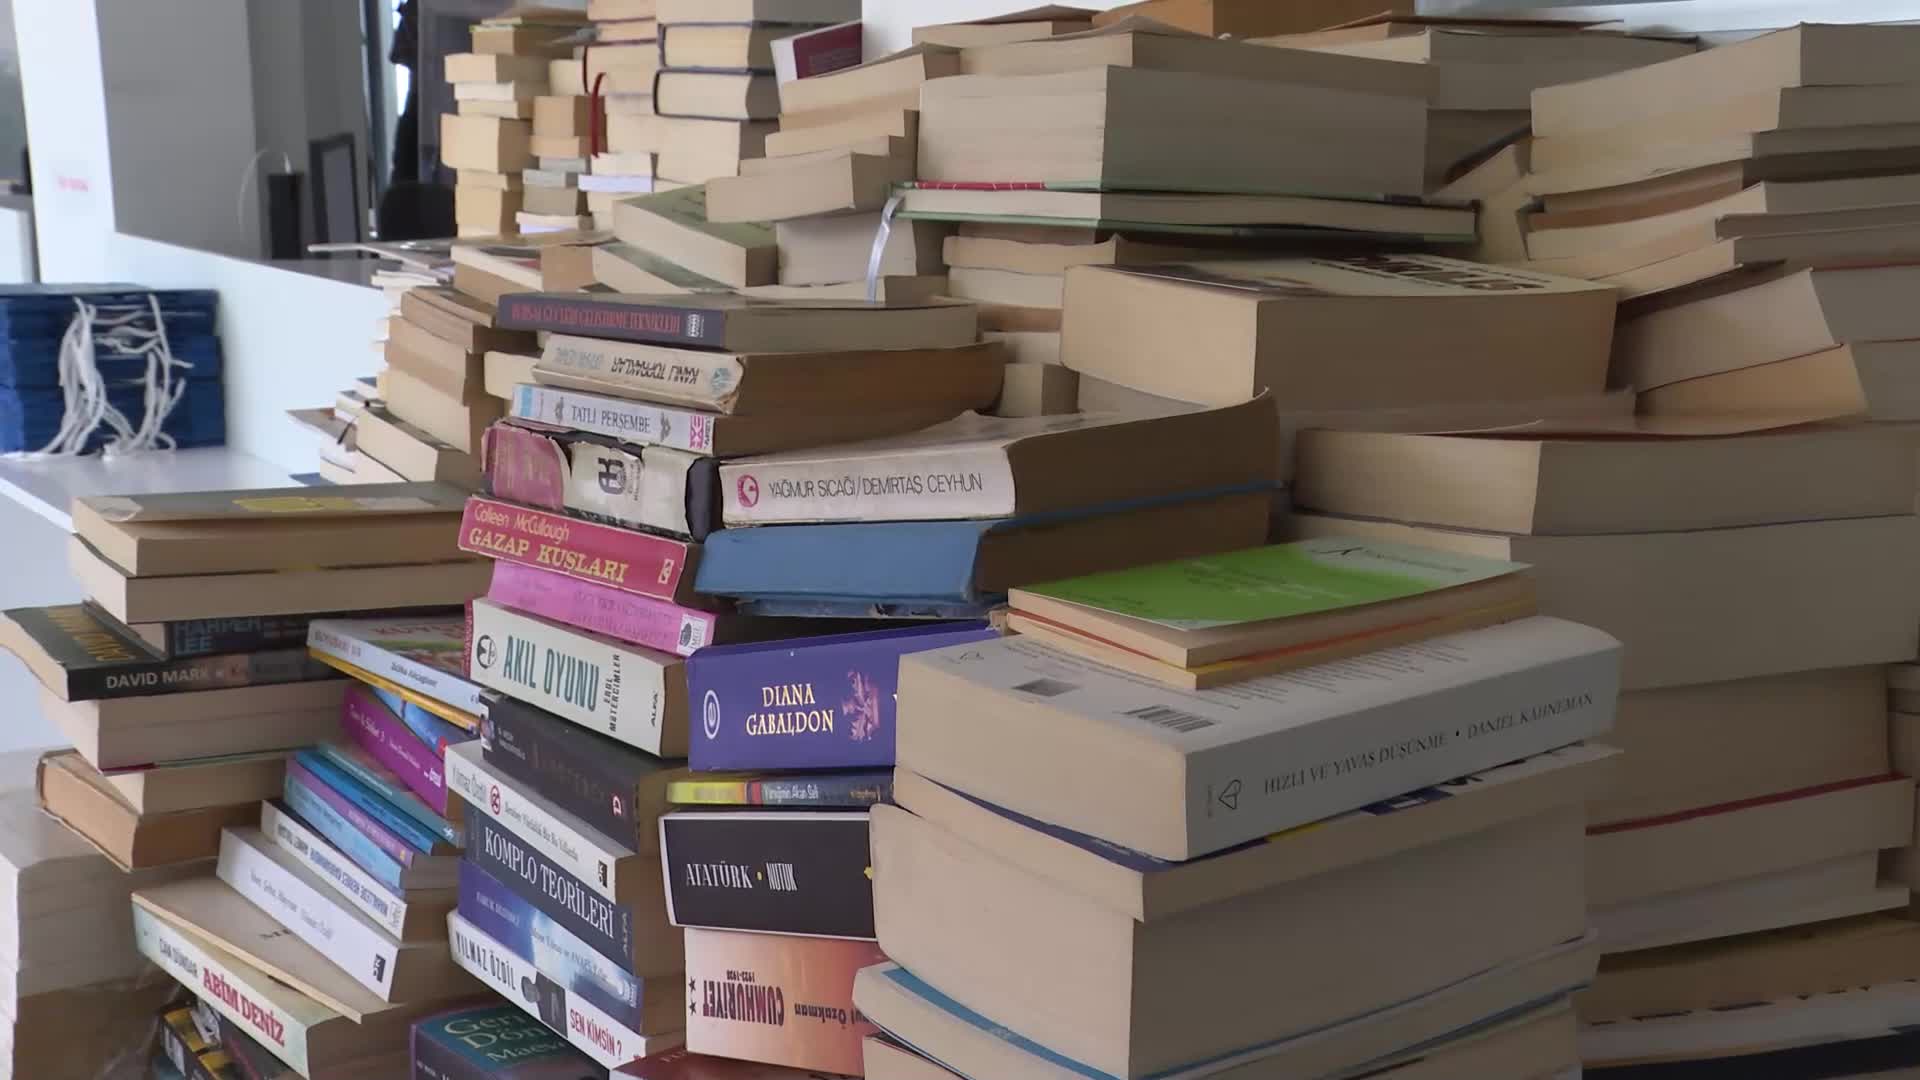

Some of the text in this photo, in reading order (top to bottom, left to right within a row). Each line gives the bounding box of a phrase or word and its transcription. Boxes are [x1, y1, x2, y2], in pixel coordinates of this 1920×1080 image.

[570, 405, 651, 434] TATLI PERŞEMBE
[769, 478, 816, 498] YAĞMUR
[926, 472, 983, 494] CEYHUN
[474, 503, 570, 545] Colleen McCullough
[468, 527, 529, 557] GAZAP
[105, 668, 210, 689] DAVID MARK
[503, 635, 537, 689] AKIL
[543, 648, 600, 713] OYUNU
[650, 692, 658, 727] ALFA
[762, 683, 816, 708] DIANA
[745, 709, 835, 737] GABALDON
[1264, 771, 1305, 795] HIZLI
[1309, 764, 1328, 784] VE
[1467, 711, 1514, 739] DANIEL
[1519, 692, 1593, 725] KAHNEMAN
[484, 825, 537, 885] KOMPLO
[539, 864, 615, 939] TEORİLERİ
[686, 860, 798, 892] ATATÜRK NUTUK
[455, 931, 487, 972] YILMAZ
[489, 950, 516, 992] ÖZDİL
[203, 967, 285, 1048] ABİM DENİZ
[703, 980, 784, 1027] CUMHURİYET
[794, 1003, 847, 1029] Özakman
[570, 1008, 585, 1033] SEN
[585, 1018, 615, 1057] KİMSİN
